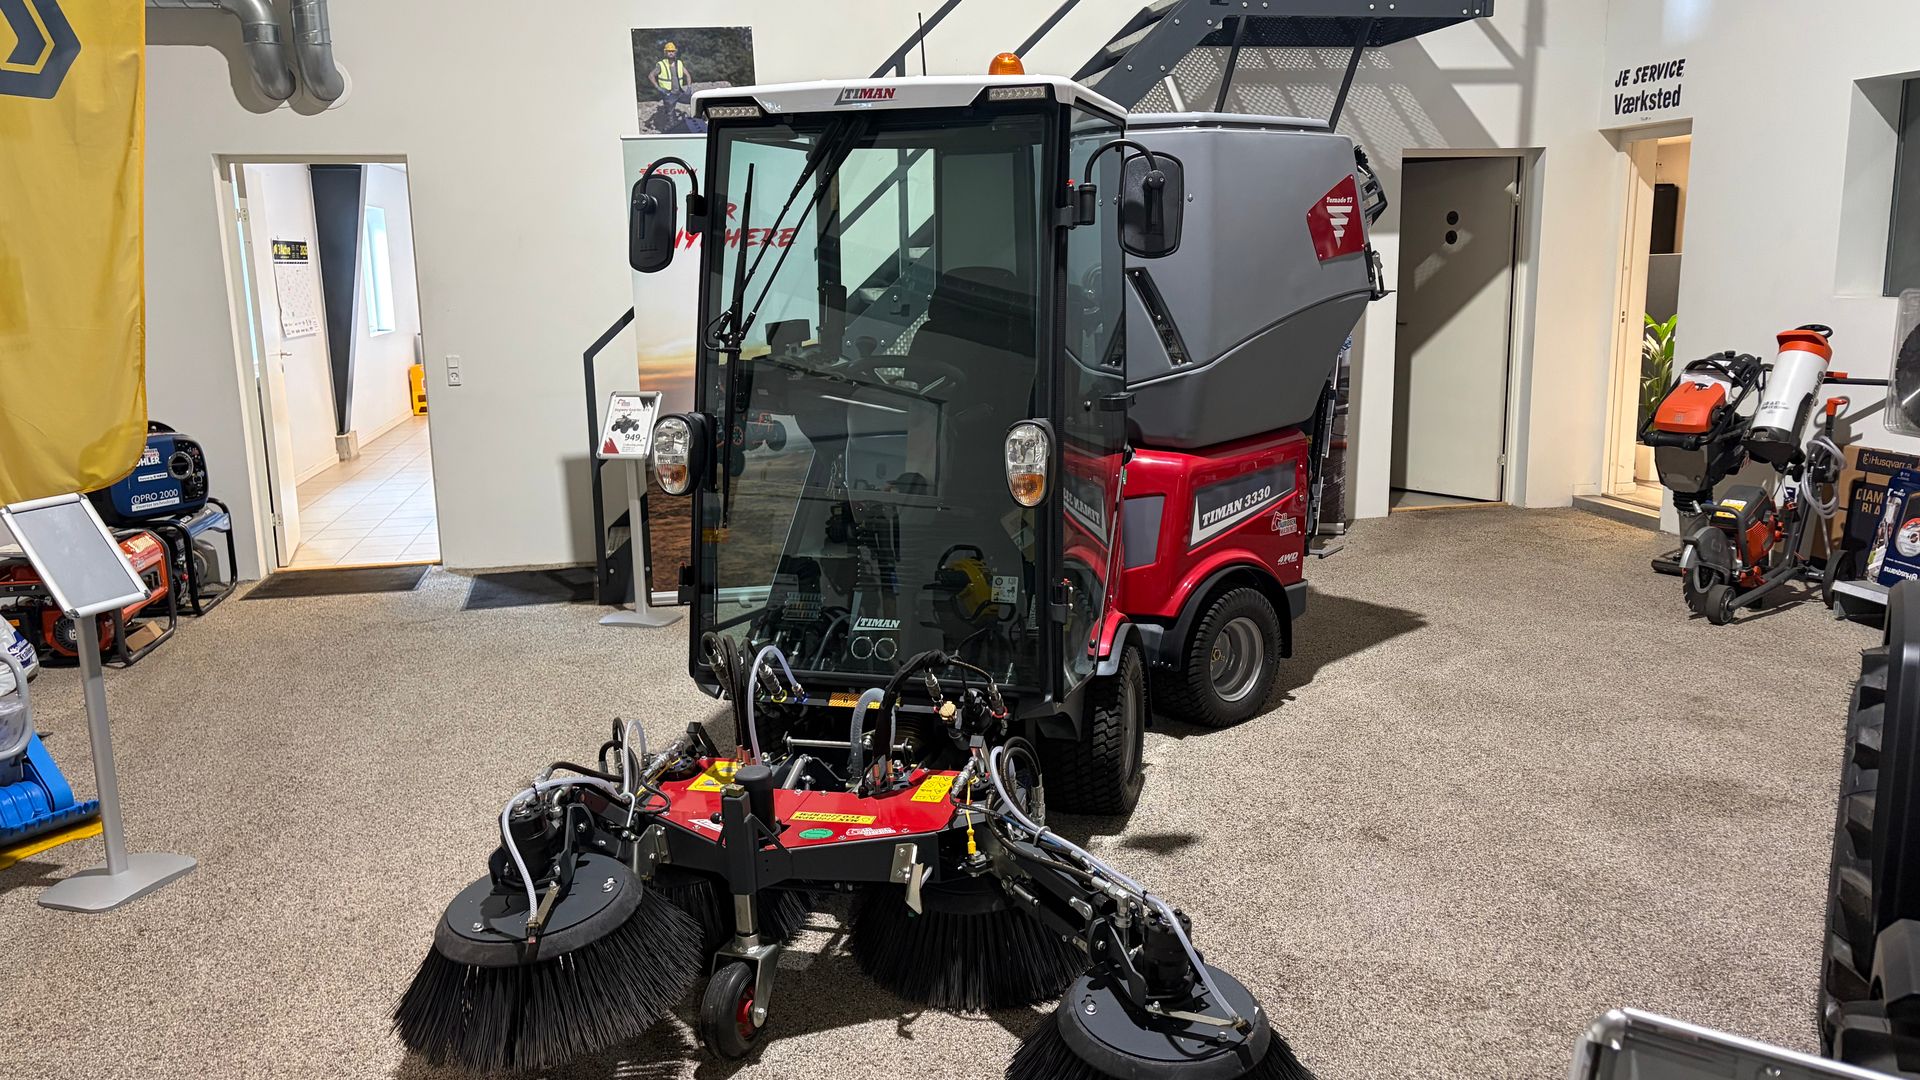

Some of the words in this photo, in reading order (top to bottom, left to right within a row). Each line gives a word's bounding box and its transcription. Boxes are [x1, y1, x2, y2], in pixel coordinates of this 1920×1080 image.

[1615, 69, 1631, 87] JE
[1633, 58, 1686, 85] SERVICE
[844, 87, 896, 99] TIMAN
[1614, 84, 1682, 115] Værksted
[160, 488, 179, 500] 2000
[1202, 497, 1243, 527] TIMAN
[1244, 485, 1271, 508] 3330
[1278, 552, 1298, 564] 4WD
[860, 617, 901, 629] TIMAN
